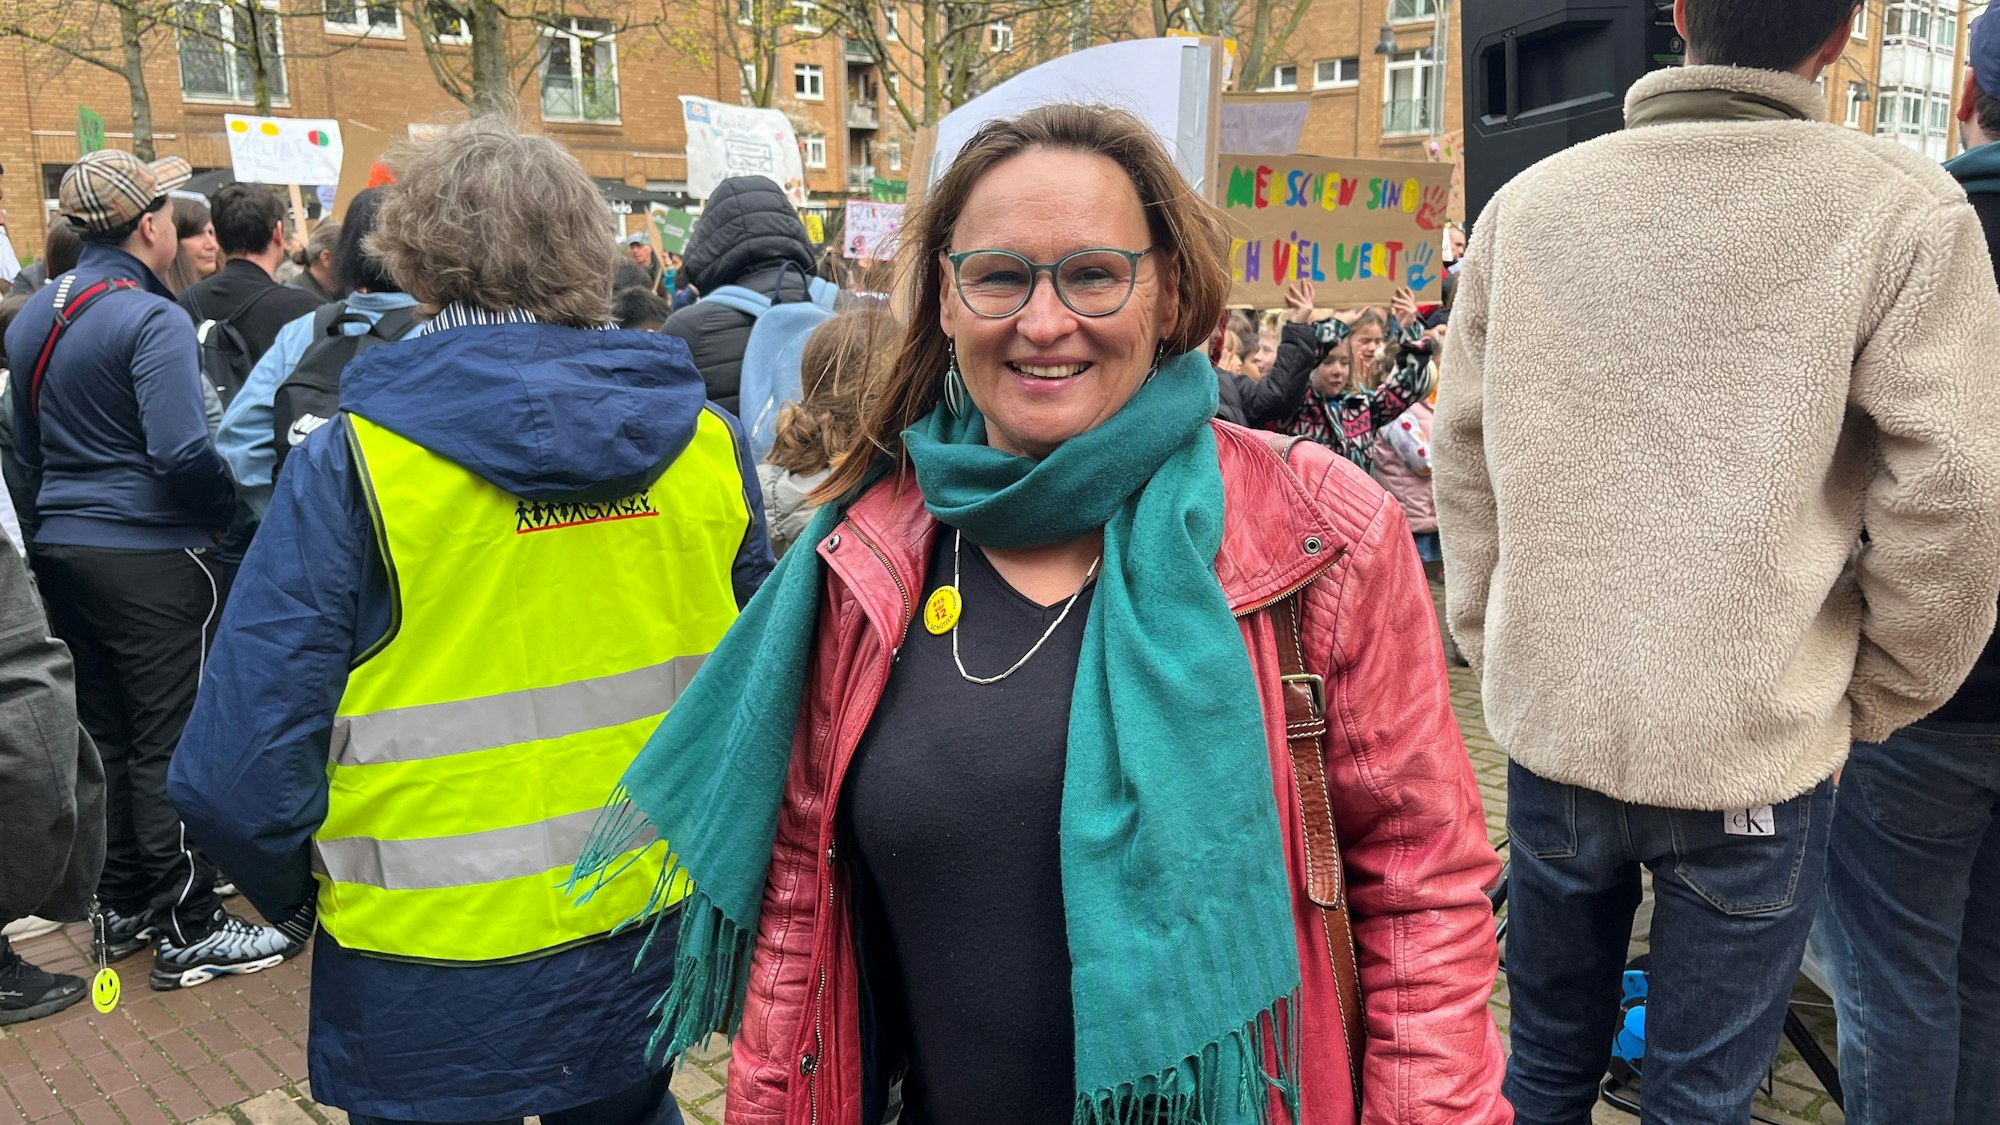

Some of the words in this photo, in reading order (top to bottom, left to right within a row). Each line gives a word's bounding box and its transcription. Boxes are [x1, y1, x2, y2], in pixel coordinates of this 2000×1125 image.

[1226, 165, 1358, 212] MENSCHEN
[1366, 177, 1421, 213] SIND
[1230, 236, 1262, 284] CH
[1335, 241, 1404, 282] WERT
[934, 608, 948, 621] 12
